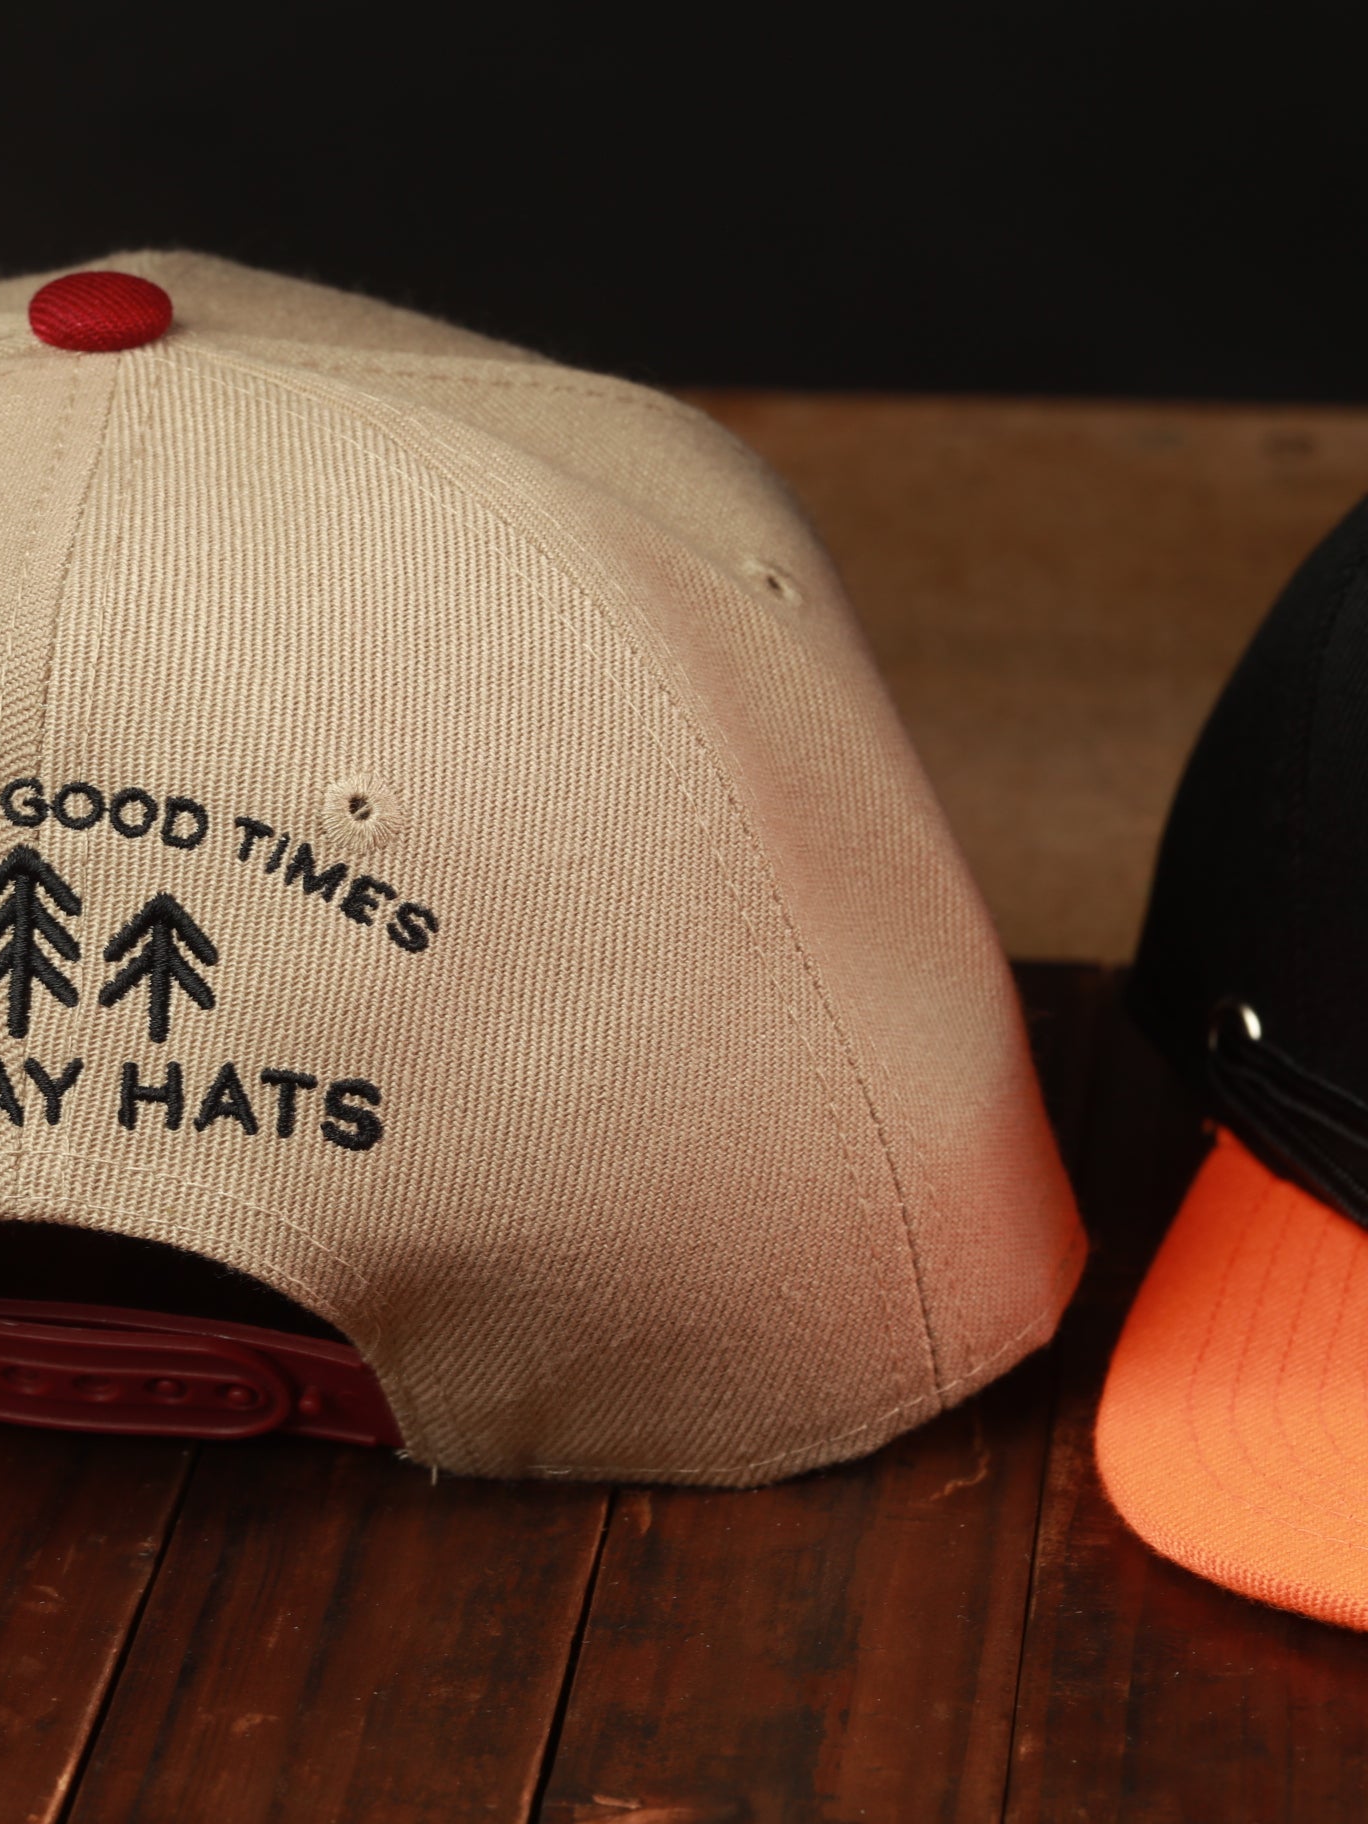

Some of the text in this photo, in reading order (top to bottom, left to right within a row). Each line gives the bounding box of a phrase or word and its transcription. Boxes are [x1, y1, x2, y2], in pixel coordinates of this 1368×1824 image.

[0, 775, 210, 852] GOOD
[233, 815, 440, 955] TIMES
[118, 1061, 388, 1152] HATS
